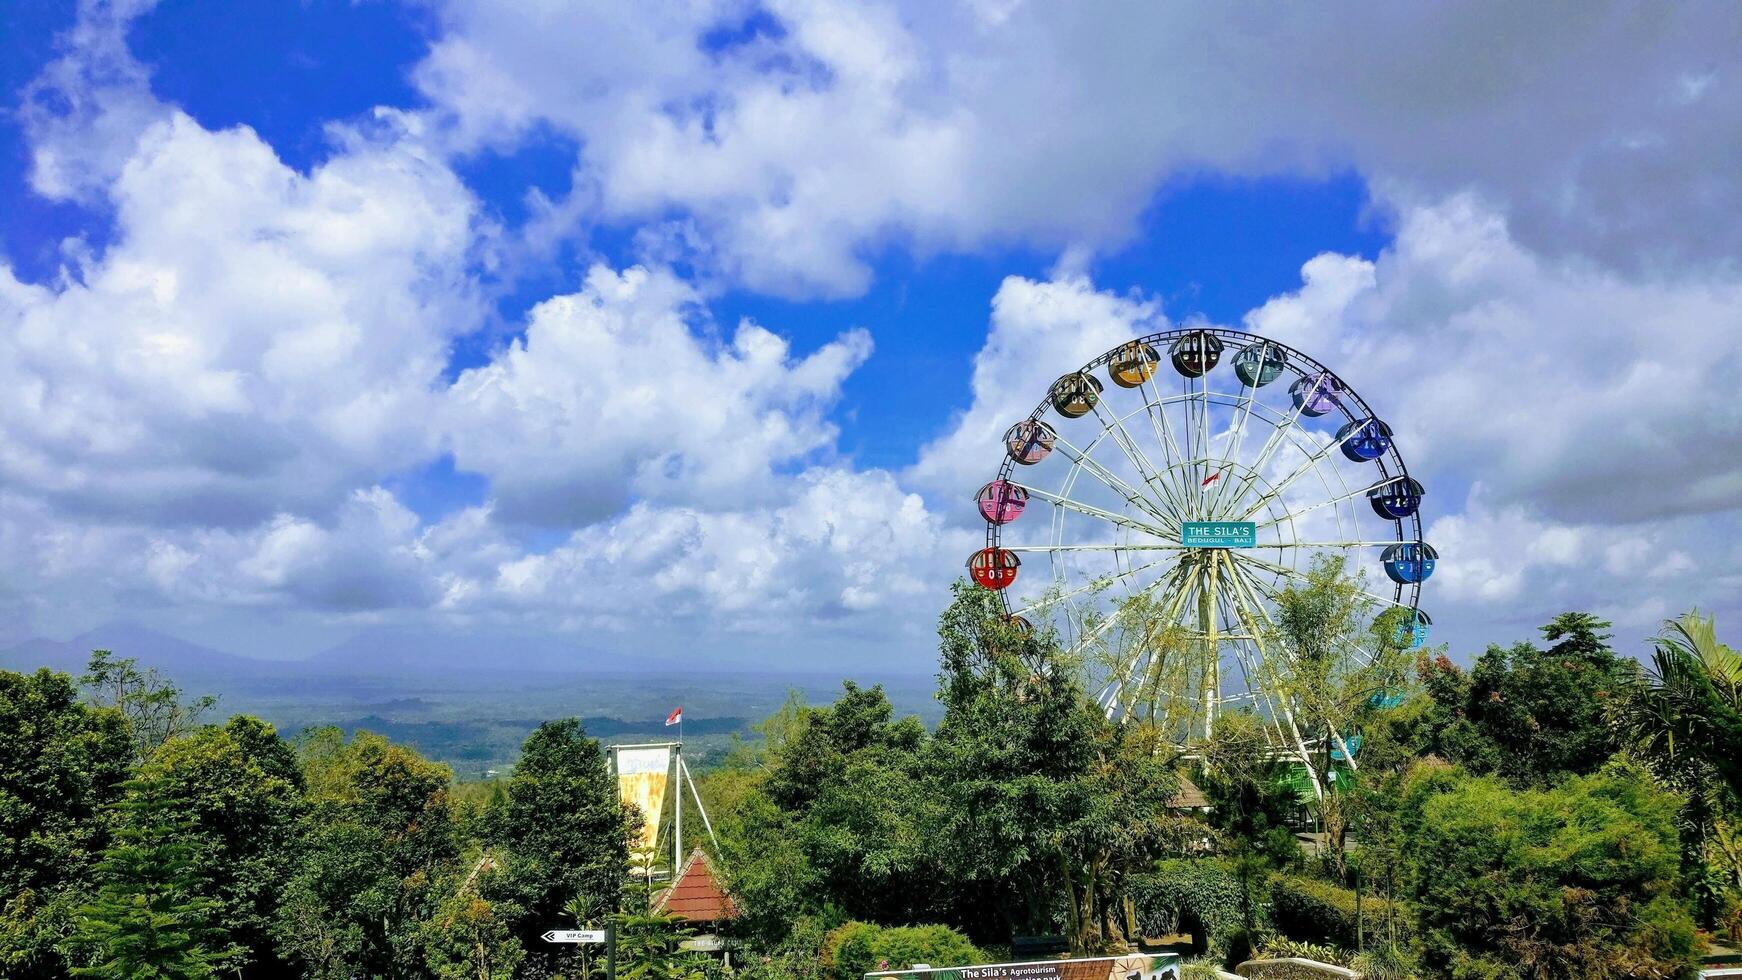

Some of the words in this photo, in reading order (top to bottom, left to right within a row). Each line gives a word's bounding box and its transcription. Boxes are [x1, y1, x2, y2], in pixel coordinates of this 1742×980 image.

[1189, 527, 1210, 535] THE
[1214, 527, 1250, 535] SILA'S
[960, 969, 979, 978] The
[981, 967, 1007, 977] Sila's
[1010, 966, 1056, 977] Agrotourism
